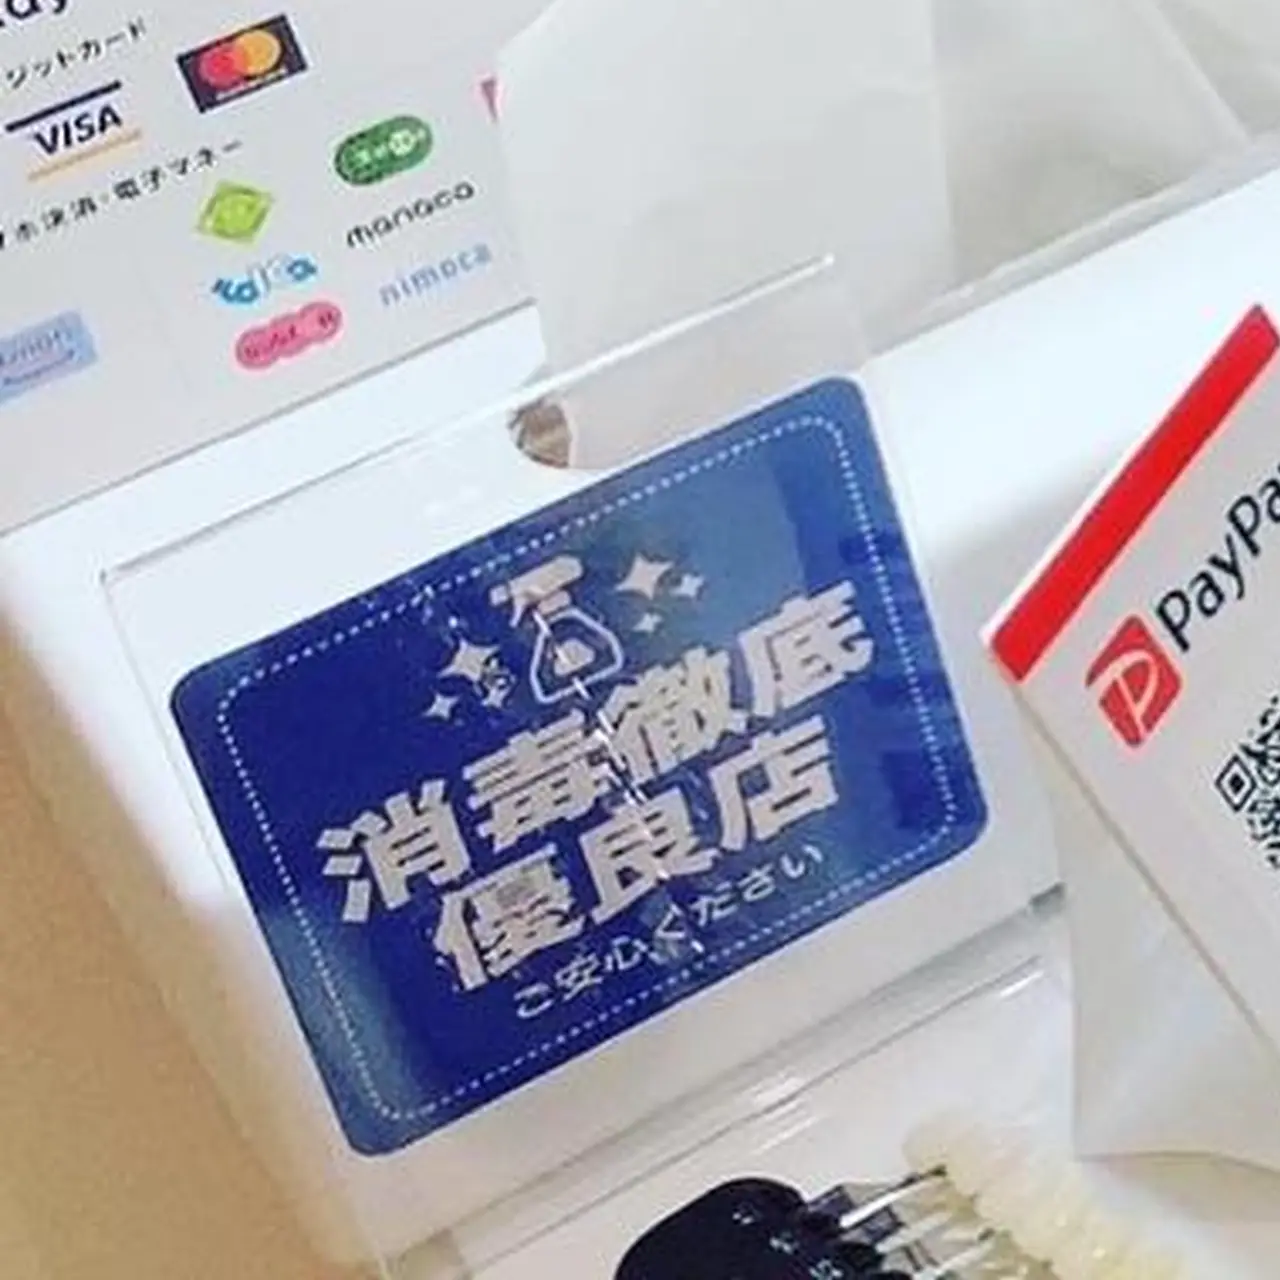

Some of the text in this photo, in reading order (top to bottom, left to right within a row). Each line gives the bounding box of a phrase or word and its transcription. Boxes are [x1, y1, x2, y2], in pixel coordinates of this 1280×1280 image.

[33, 103, 124, 156] VISA
[318, 578, 876, 926] 消毒徹底
[431, 715, 840, 992] 優良店
